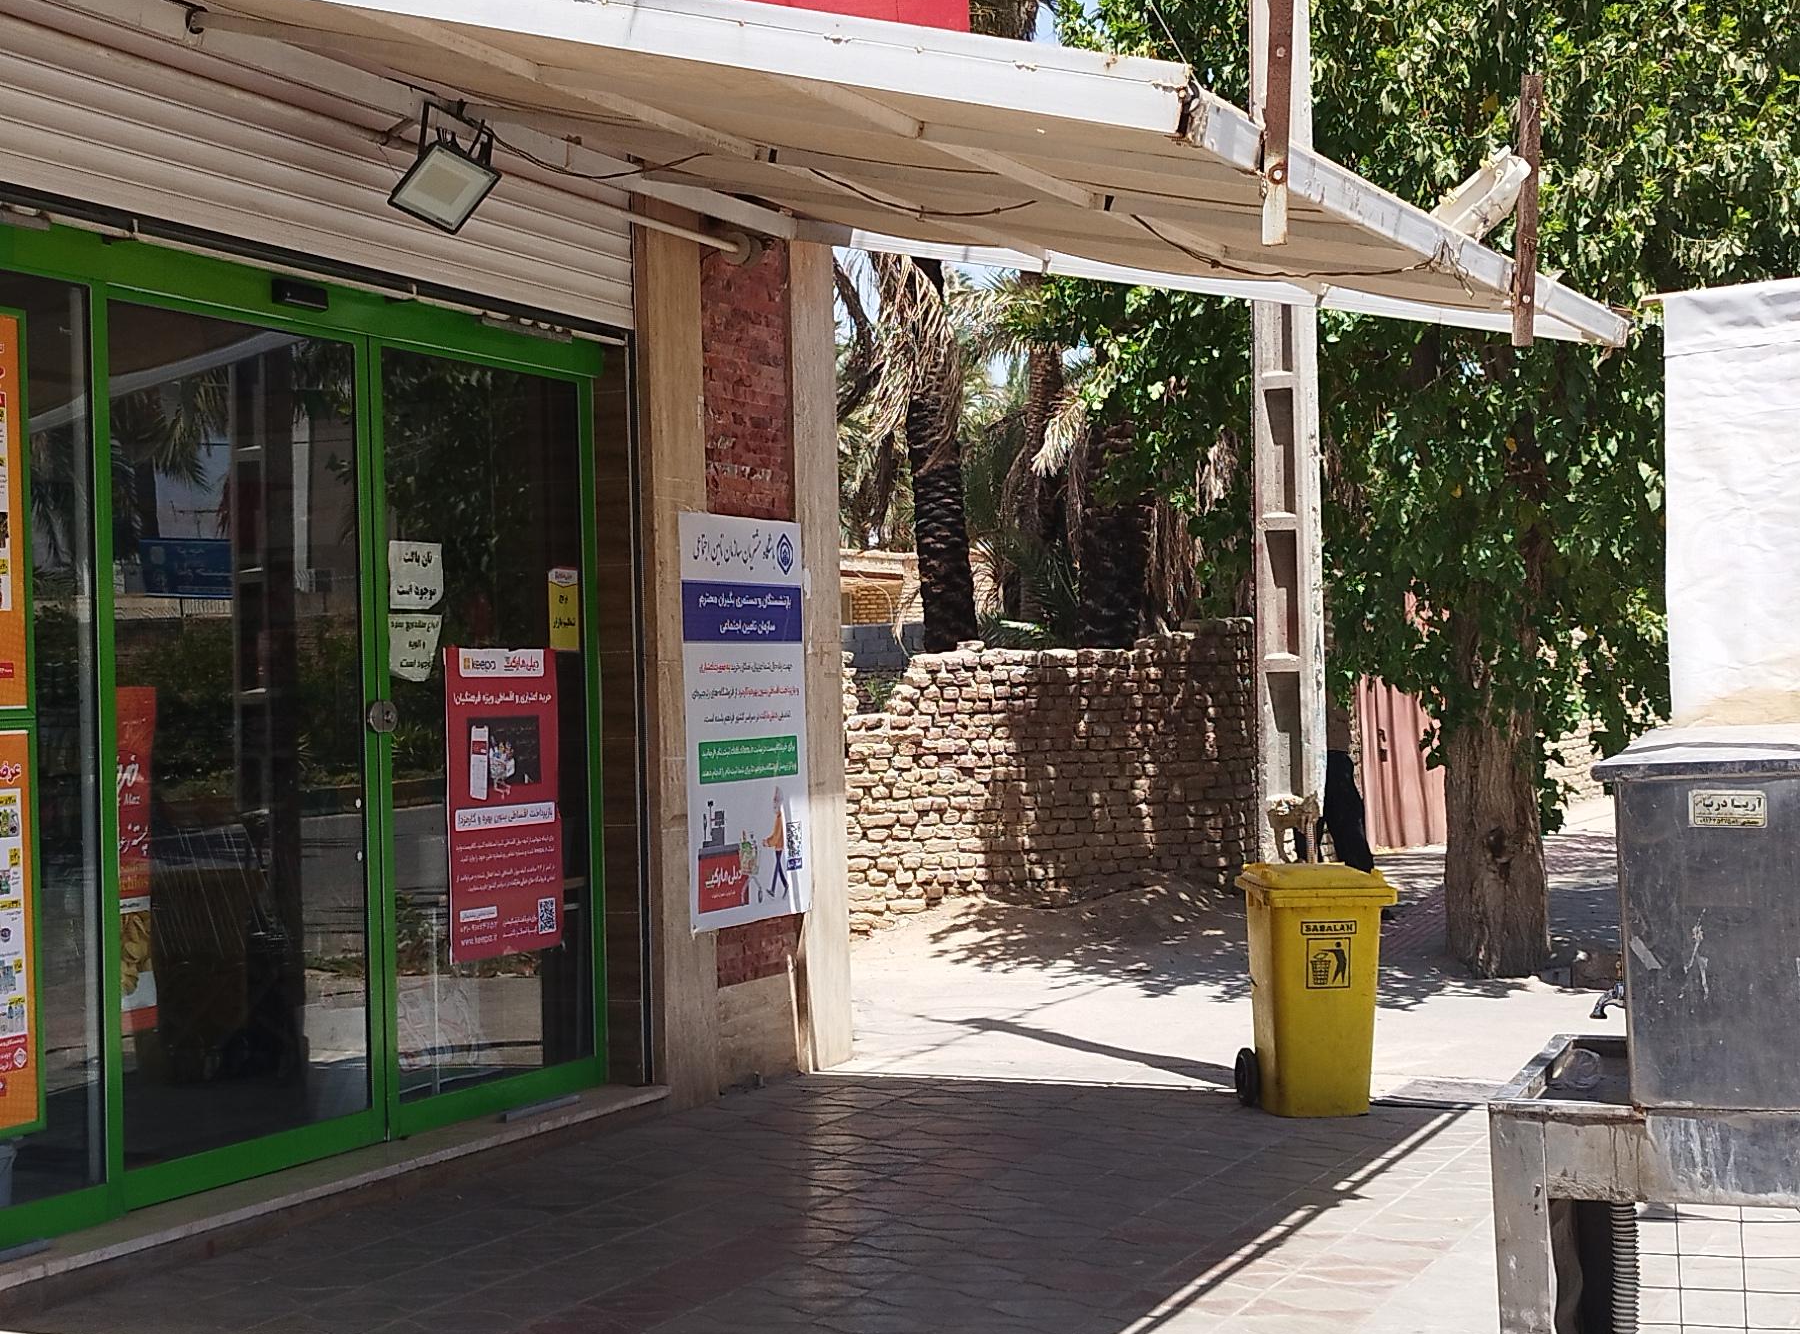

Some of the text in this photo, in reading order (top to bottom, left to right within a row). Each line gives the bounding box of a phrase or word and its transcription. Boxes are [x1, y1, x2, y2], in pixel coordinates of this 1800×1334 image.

[724, 538, 743, 564] سازمان
[719, 618, 741, 634] اجتماعی
[758, 619, 776, 635] سازمان
[1304, 923, 1353, 933] SABALAN
